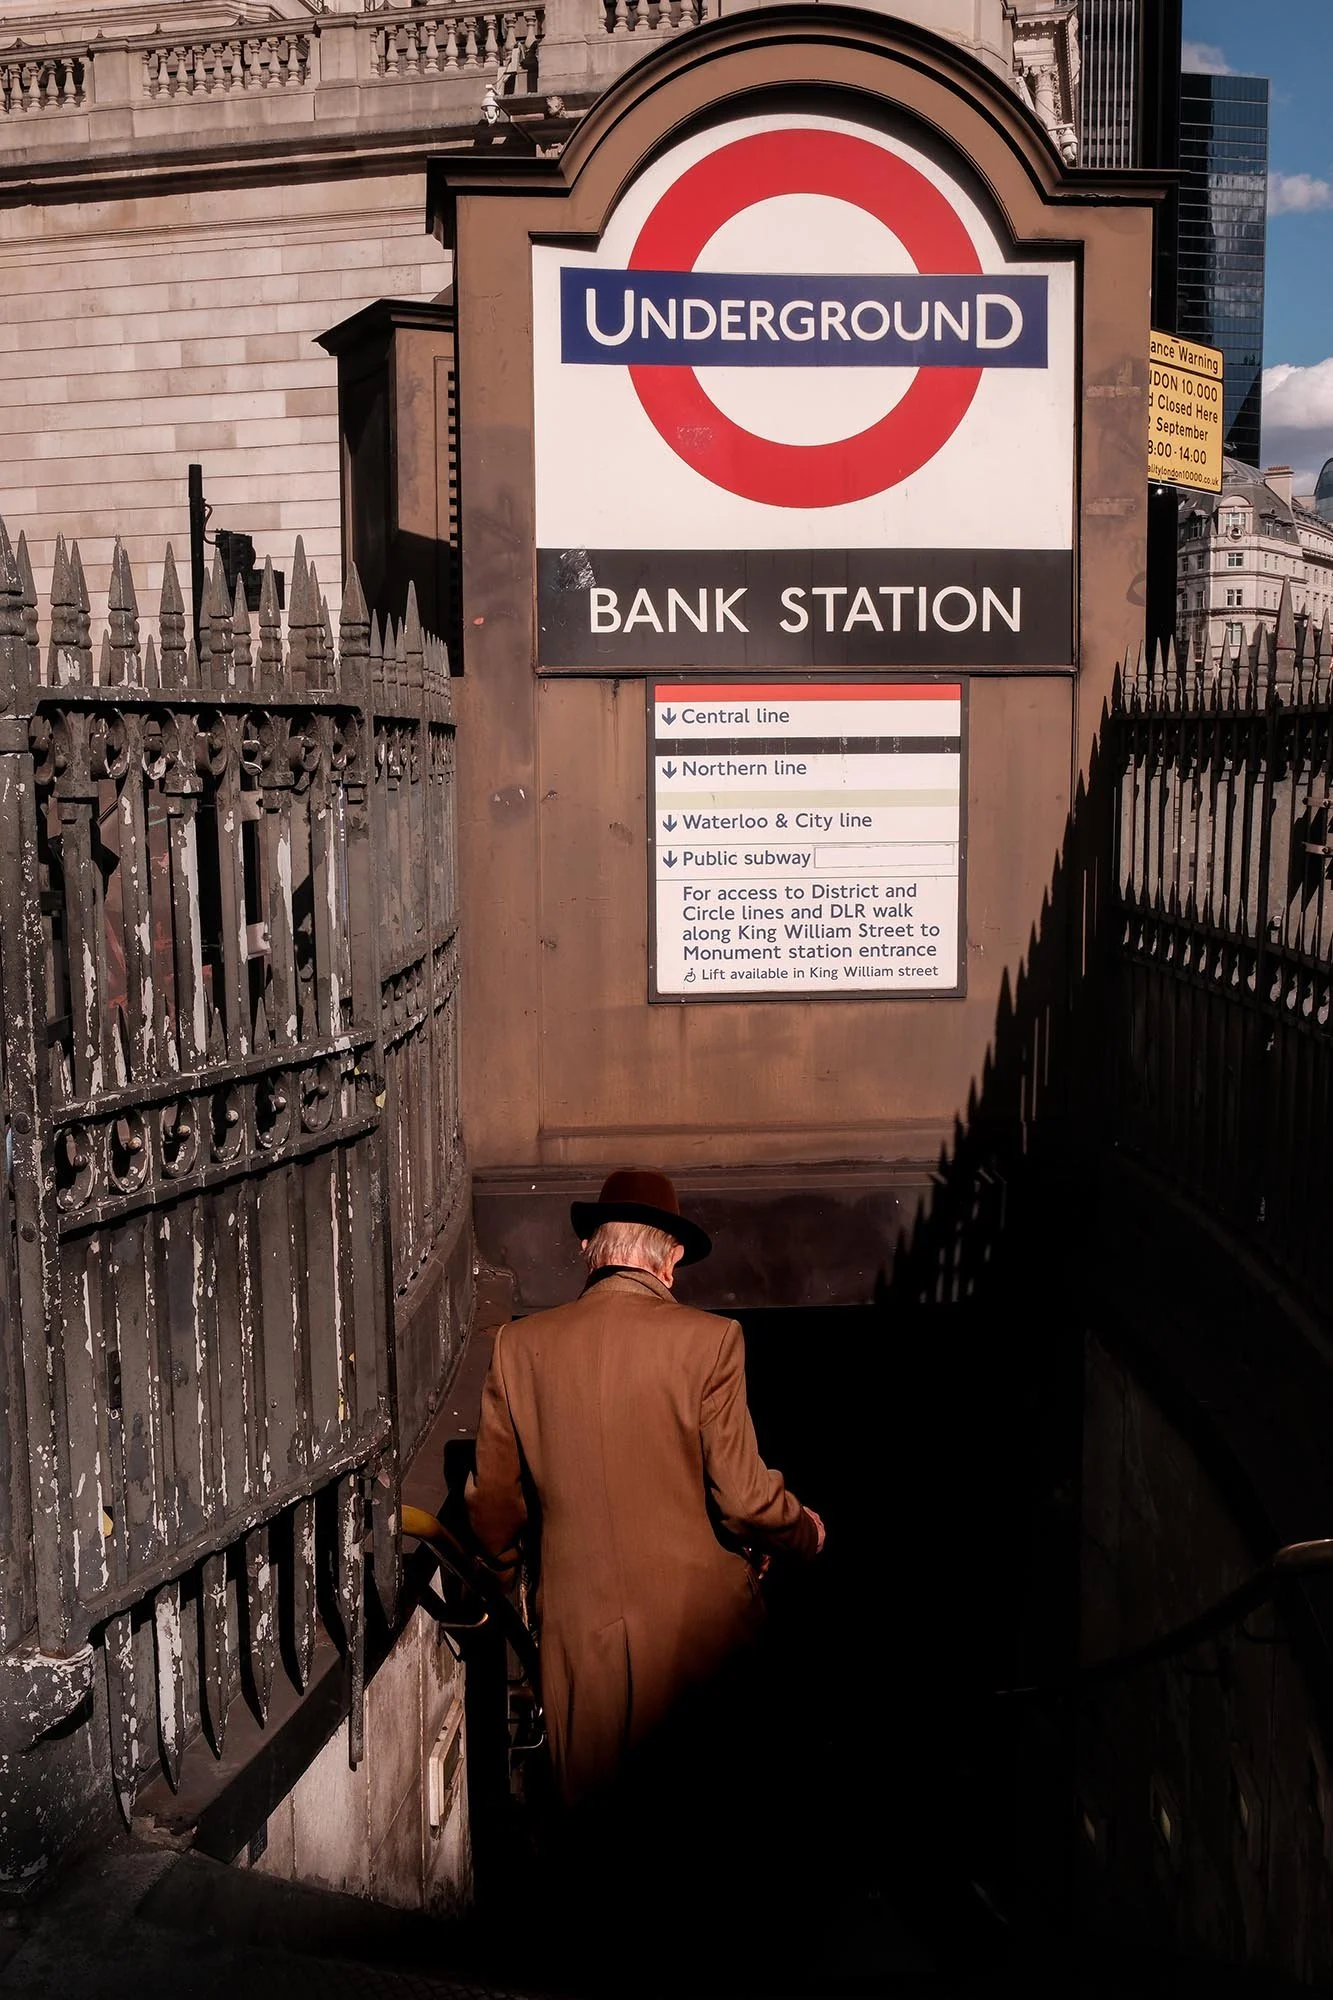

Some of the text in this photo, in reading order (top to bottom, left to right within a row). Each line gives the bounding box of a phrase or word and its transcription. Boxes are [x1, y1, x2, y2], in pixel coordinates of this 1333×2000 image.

[586, 289, 1023, 348] UNDERGROUND
[1179, 345, 1218, 374] Warning
[1158, 394, 1192, 416] Closed
[1196, 403, 1218, 423] Here
[1156, 416, 1208, 441] September
[1180, 446, 1206, 464] 14:00
[590, 586, 1021, 633] BANK STATION
[682, 708, 789, 723] Central line
[683, 760, 807, 776] Northern line
[683, 813, 872, 831] Waterloo & City line
[683, 850, 811, 869] Public subway
[683, 883, 917, 901] For access to District and
[683, 903, 913, 921] Circle lines and DLR walk
[683, 923, 940, 943] along King William Street to
[683, 944, 937, 961] Monument station entrance
[702, 966, 938, 981] Lift available in King William street
